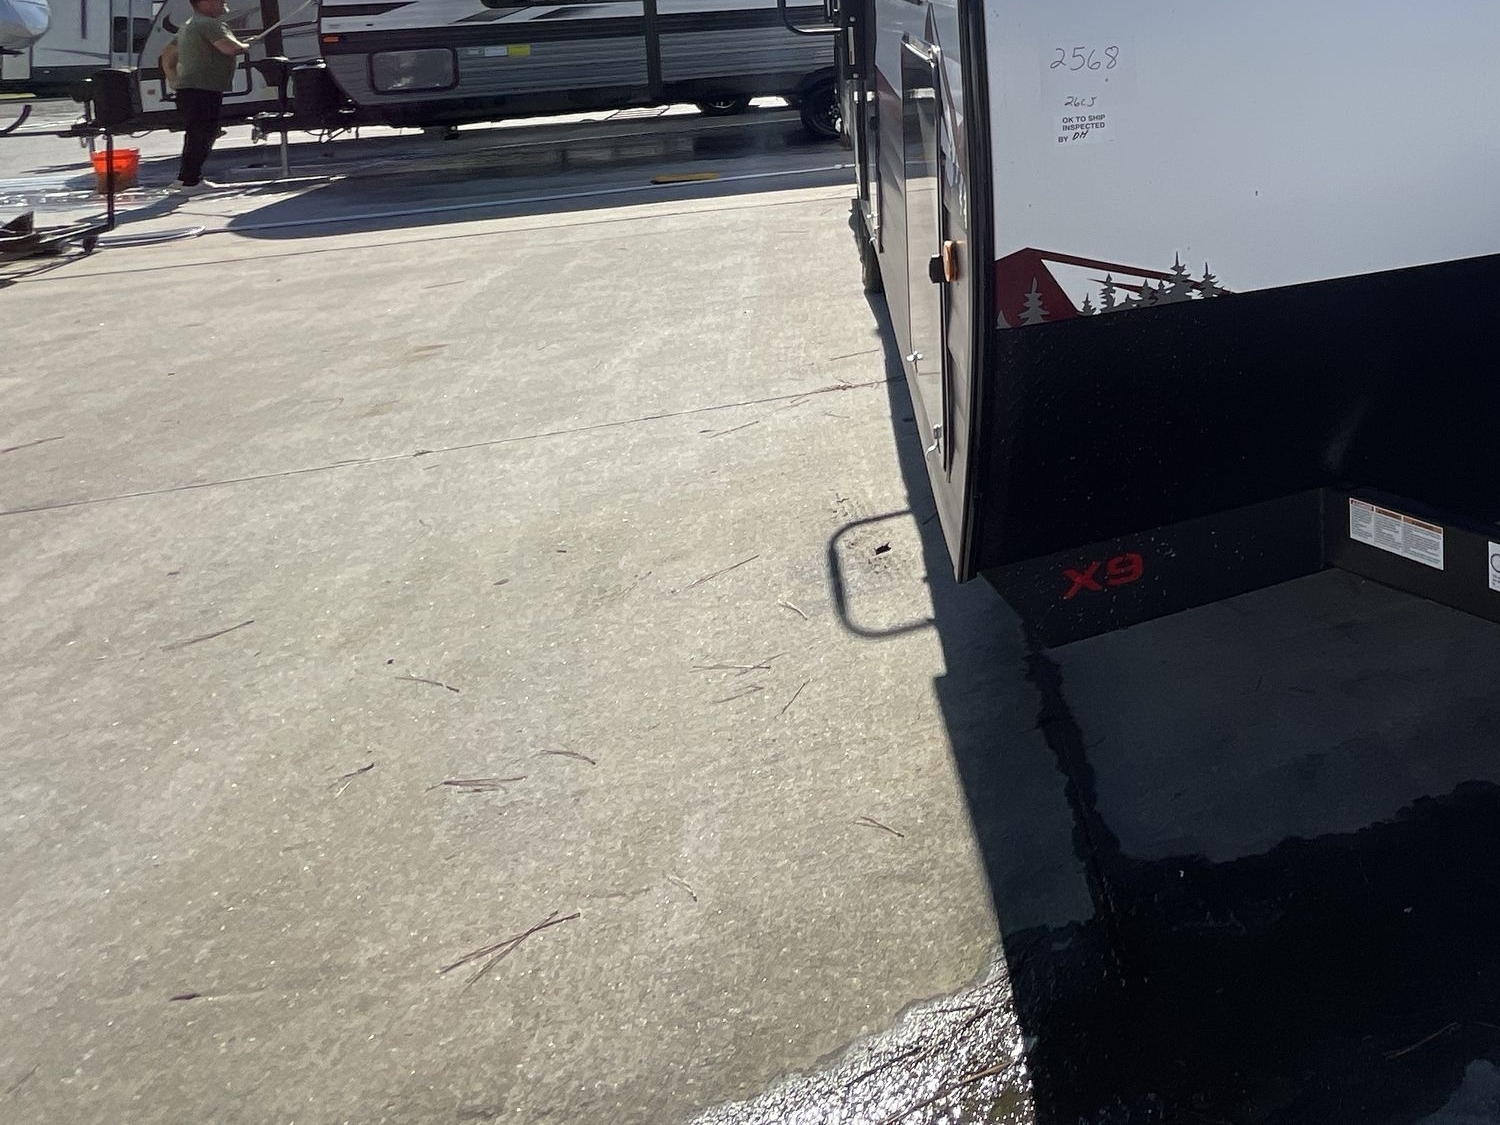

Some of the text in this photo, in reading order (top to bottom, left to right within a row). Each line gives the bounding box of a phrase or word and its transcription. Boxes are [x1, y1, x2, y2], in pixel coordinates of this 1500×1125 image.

[1050, 45, 1119, 71] 2568
[1062, 114, 1106, 124] OK TO SHIP
[1062, 121, 1106, 131] INSPECTED
[1061, 550, 1144, 601] X9
